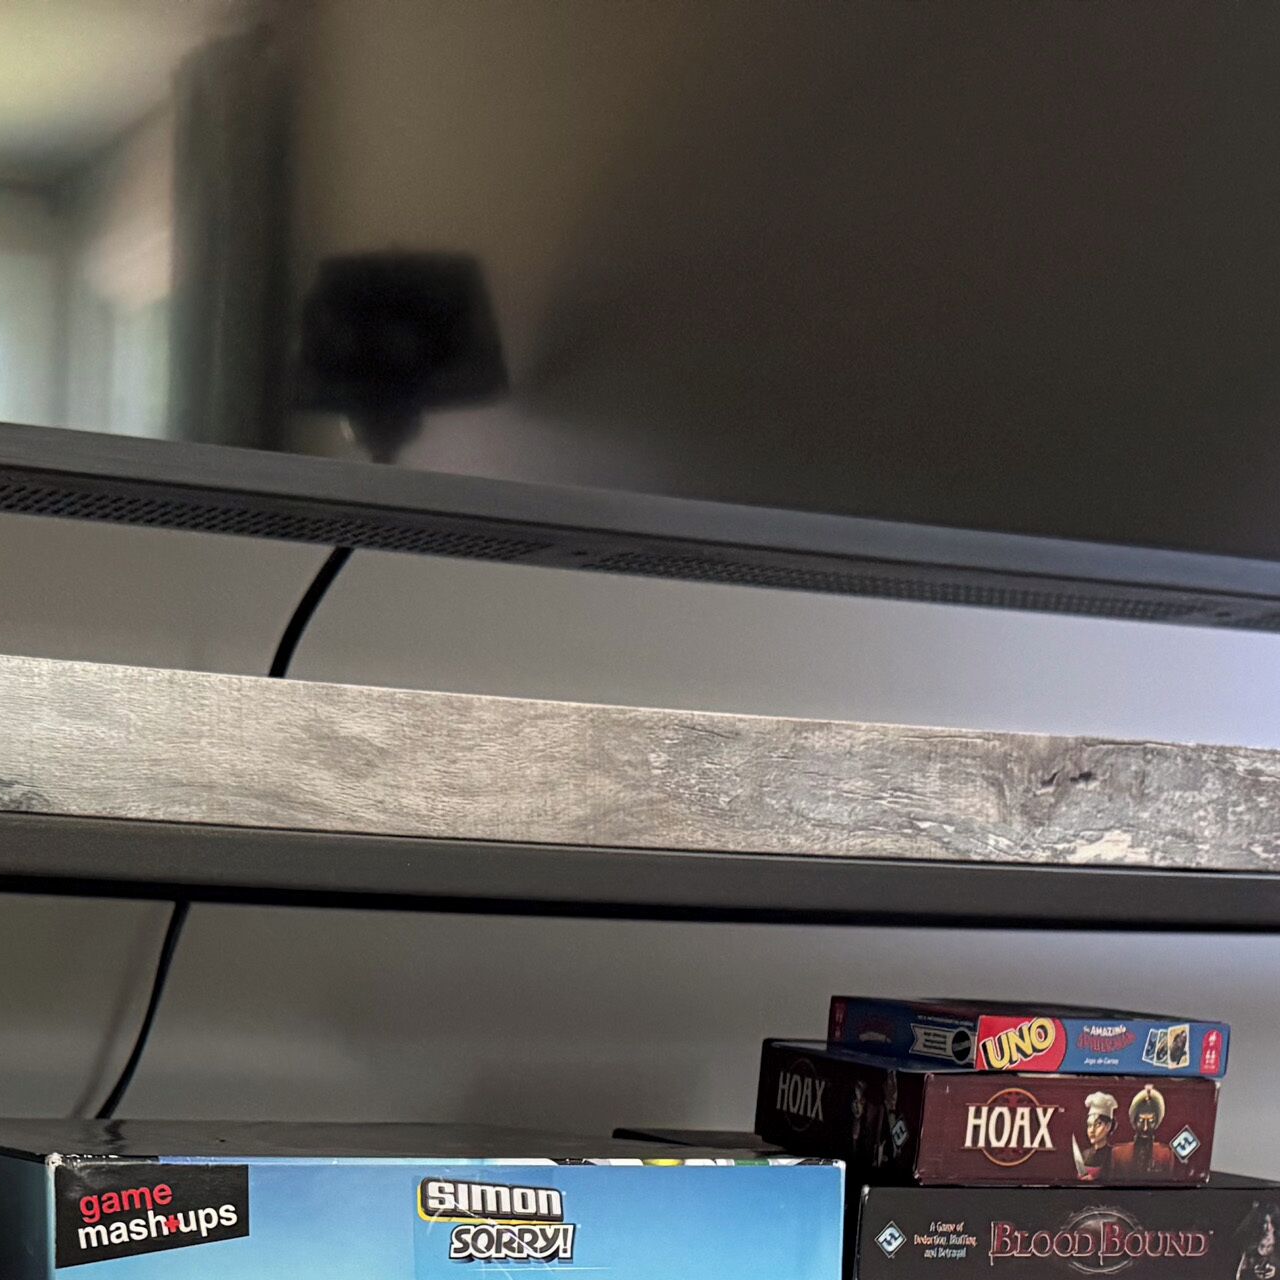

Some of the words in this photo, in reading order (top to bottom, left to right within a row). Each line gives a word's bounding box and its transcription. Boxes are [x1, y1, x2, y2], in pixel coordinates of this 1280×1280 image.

[984, 1017, 1057, 1069] UNO
[776, 1070, 826, 1122] HOAX
[964, 1106, 1055, 1150] HOAX
[80, 1183, 174, 1224] game
[451, 1224, 572, 1258] SORRY!
[990, 1221, 1094, 1265] BLOOD
[1099, 1221, 1209, 1265] BOUND
